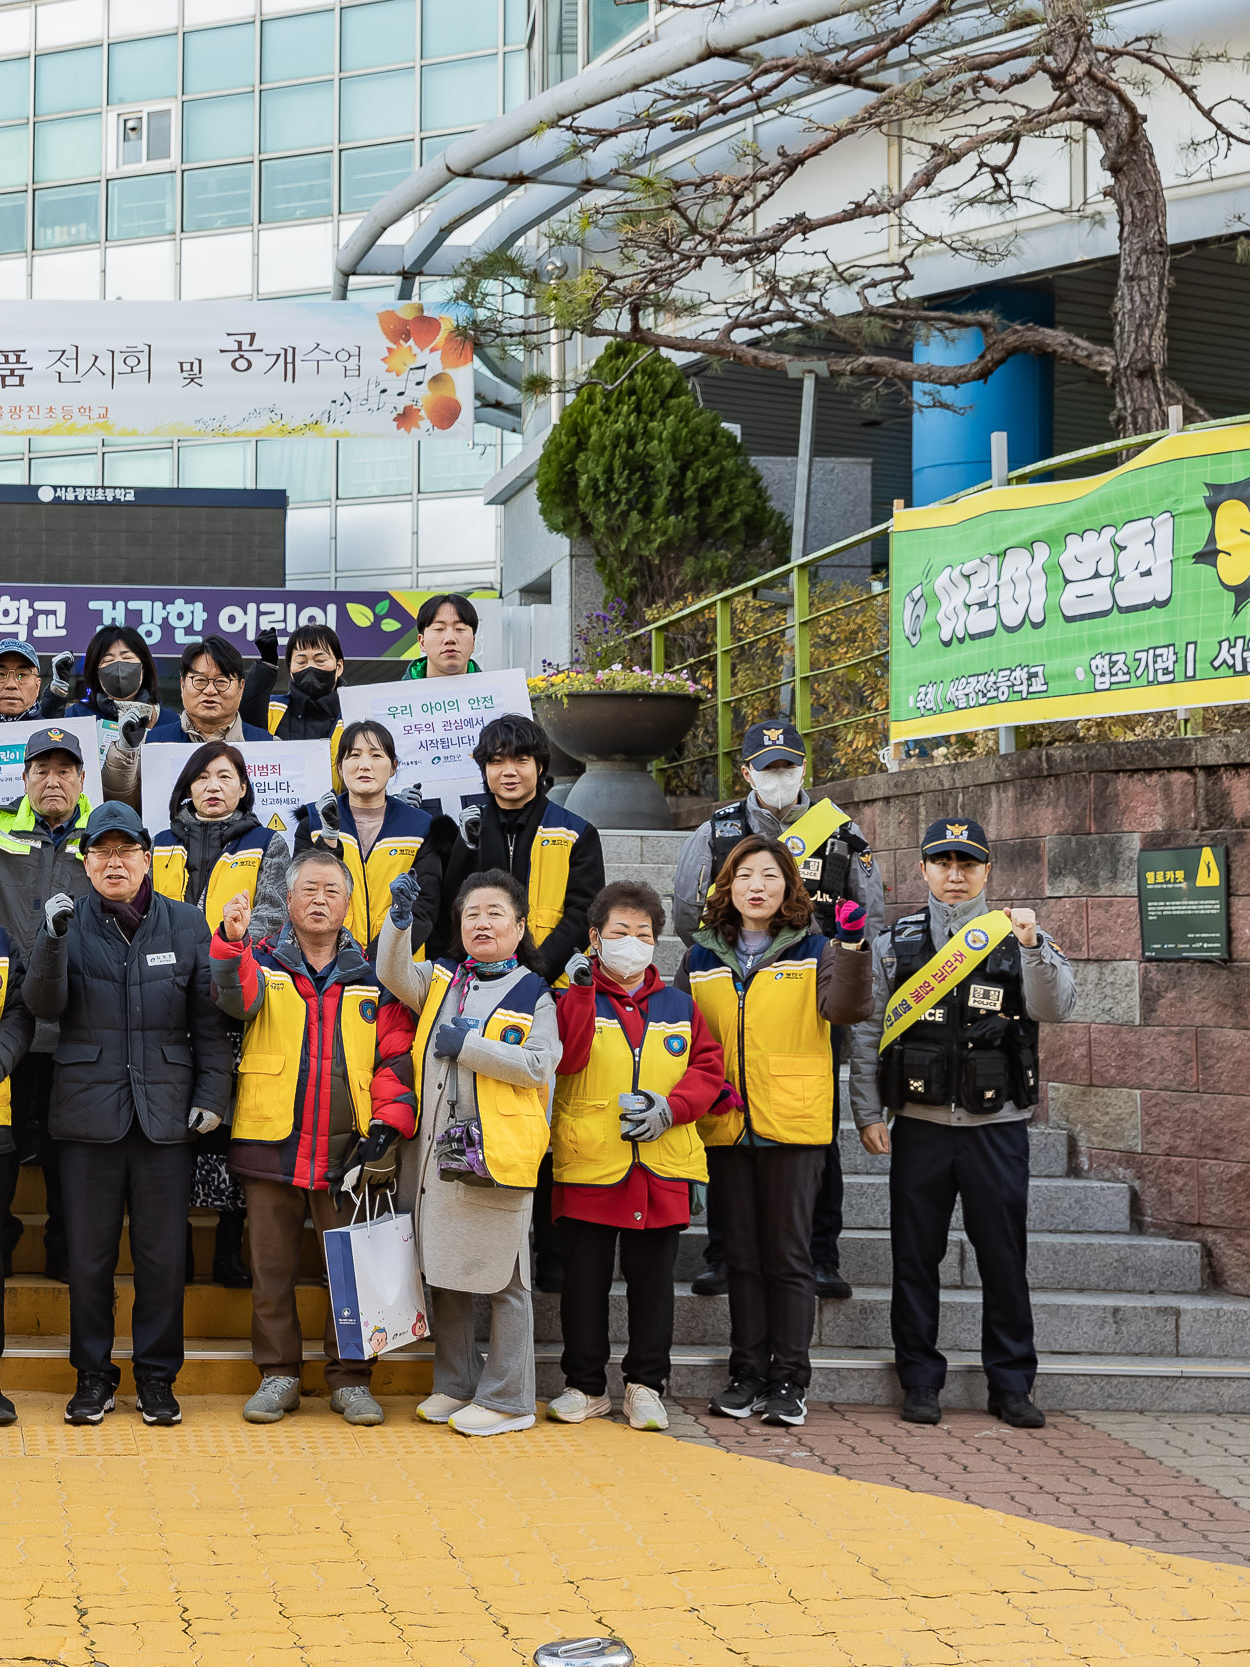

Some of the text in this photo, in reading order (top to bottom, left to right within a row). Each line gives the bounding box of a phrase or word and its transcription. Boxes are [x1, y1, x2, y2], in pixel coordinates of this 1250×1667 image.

[45, 343, 152, 390] 전시회
[177, 358, 204, 388] 및
[219, 332, 361, 384] 공개수업
[55, 486, 136, 502] 서울광진초등학교
[933, 510, 1175, 648] 어린이 범죄
[1090, 652, 1131, 691] 협조
[1134, 643, 1178, 684] 기관
[946, 664, 1048, 709] 서울광진초등학교
[387, 695, 495, 719] 우리 아이의 안전
[403, 717, 486, 736] 모두의 관심에서
[418, 735, 477, 752] 시작됩니다!
[251, 781, 295, 793] 입니다.
[261, 797, 300, 805] 신고하세요!
[931, 949, 968, 984] 주민과
[909, 980, 936, 1005] 함께
[972, 999, 998, 1007] POLICE
